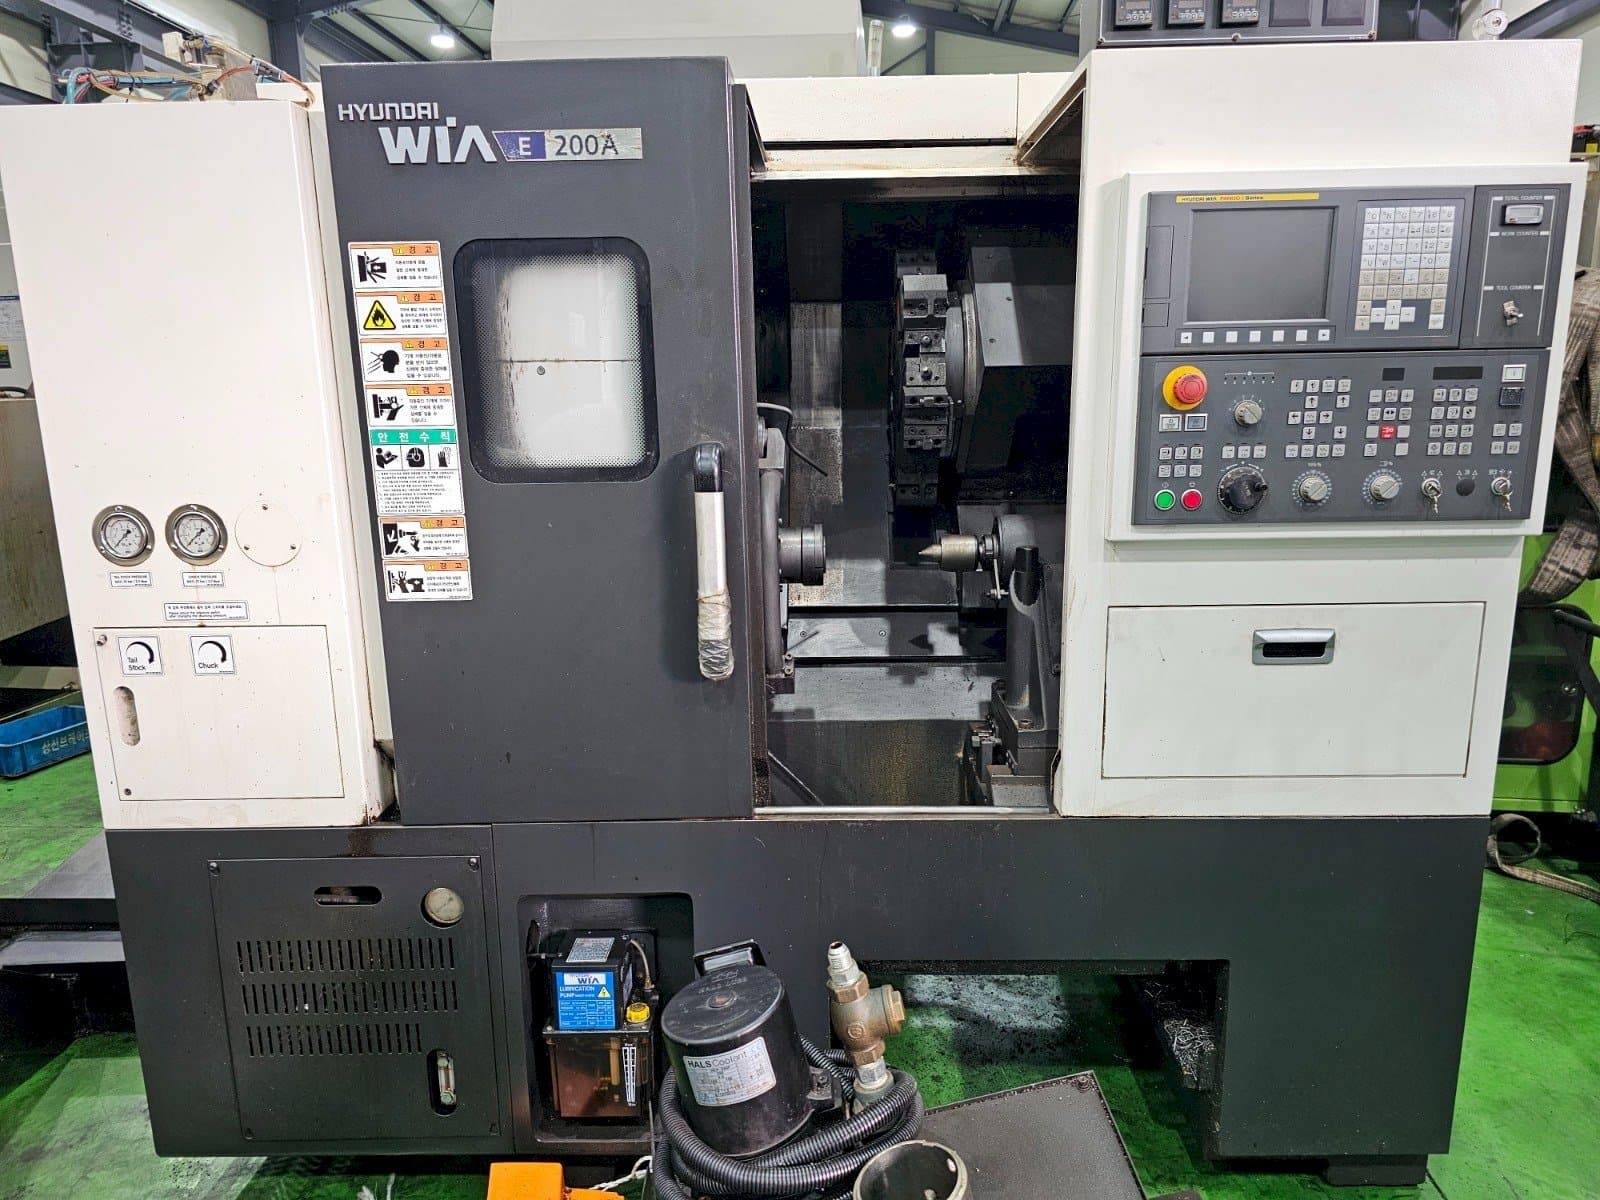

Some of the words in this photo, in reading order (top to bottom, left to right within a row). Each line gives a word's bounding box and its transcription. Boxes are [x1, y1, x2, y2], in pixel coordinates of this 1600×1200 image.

[337, 102, 439, 121] HYUNDAI
[518, 136, 532, 156] E
[554, 133, 619, 156] 200A
[127, 656, 138, 664] Tail
[687, 1060, 712, 1069] HALS
[711, 1051, 748, 1067] Coolant
